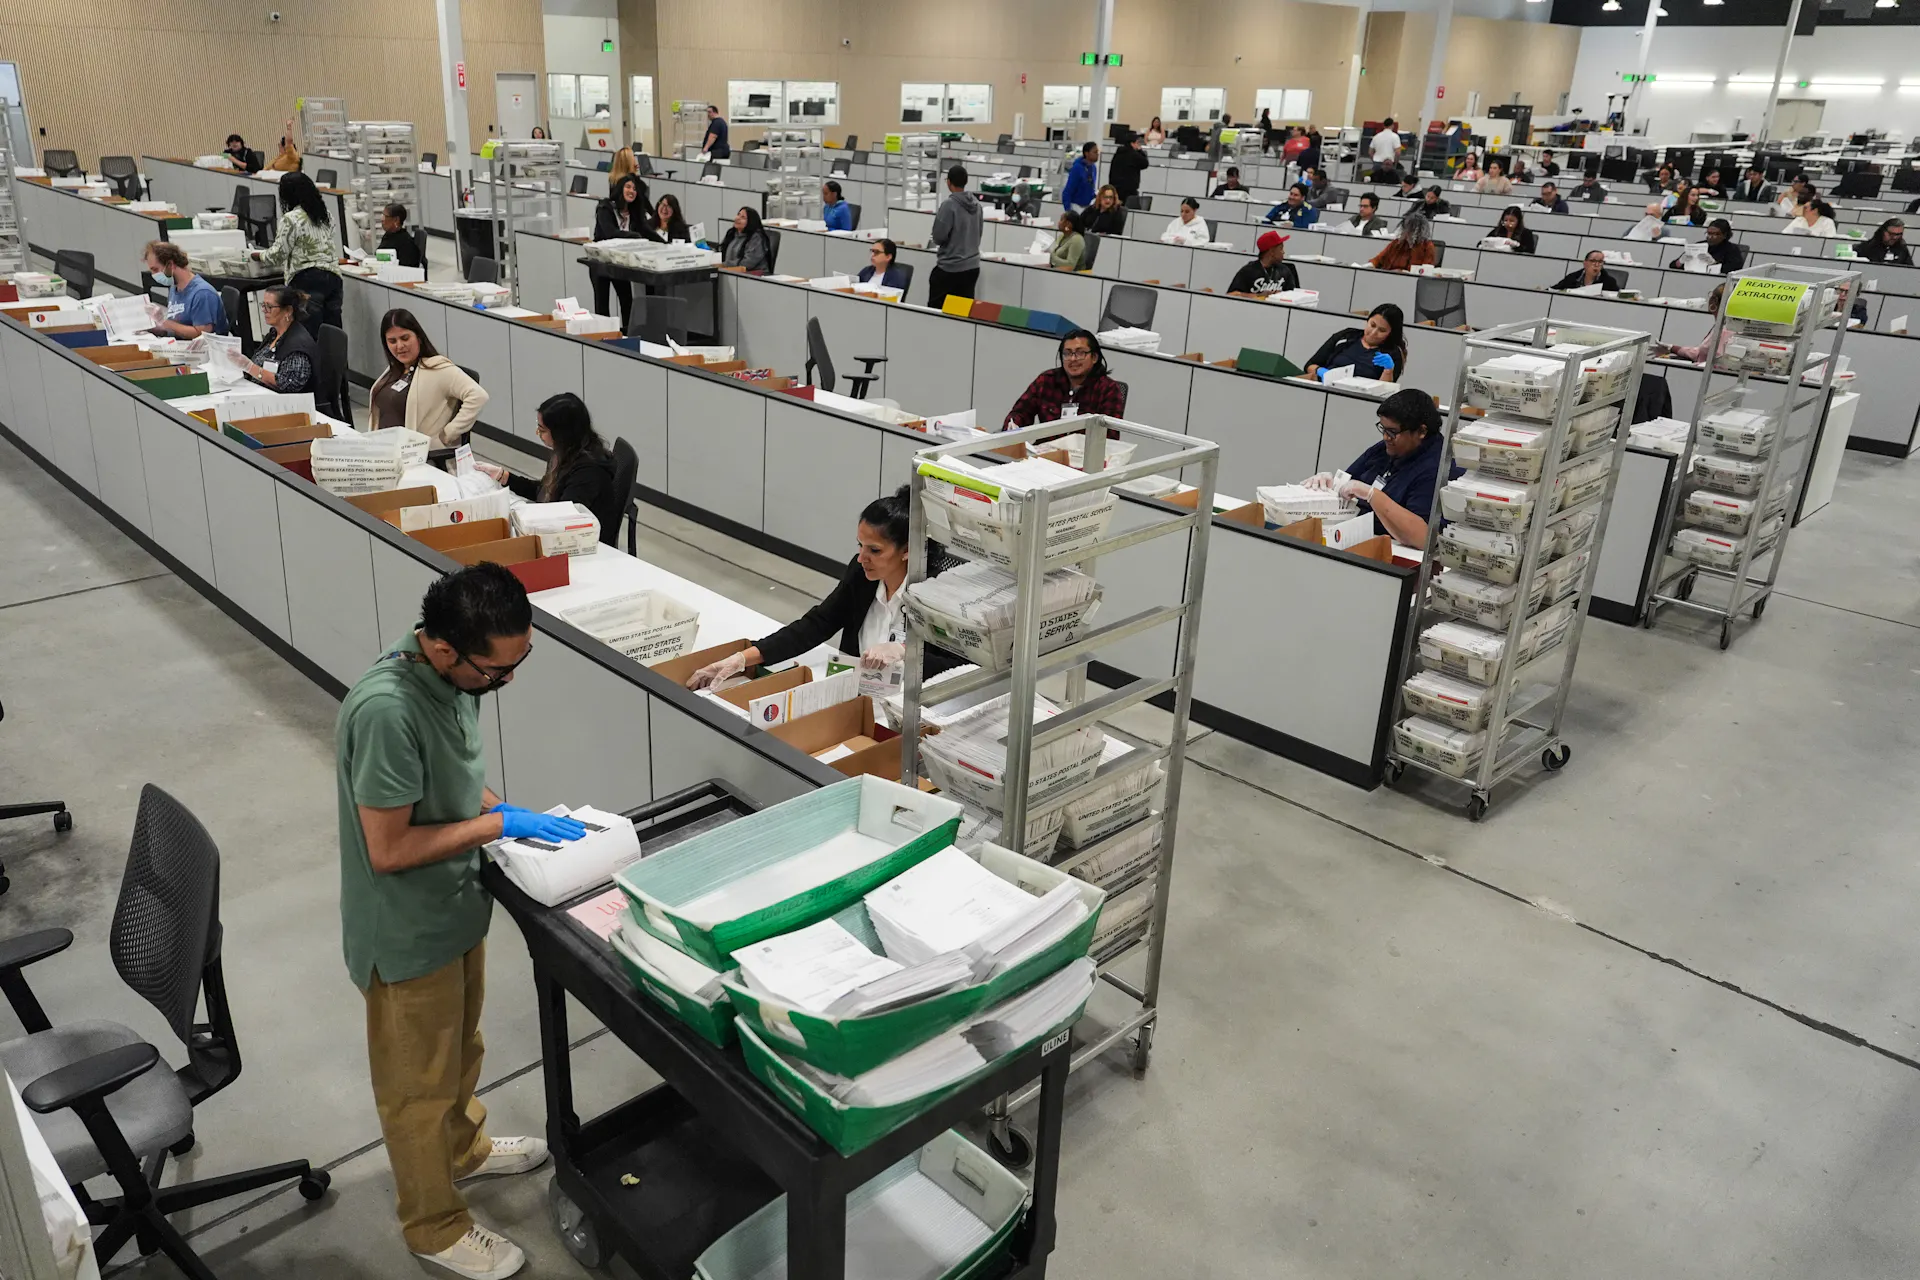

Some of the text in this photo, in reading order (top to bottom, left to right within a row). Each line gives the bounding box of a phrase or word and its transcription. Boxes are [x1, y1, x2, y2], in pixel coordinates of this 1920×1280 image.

[1746, 280, 1776, 288] READY
[1736, 290, 1796, 302] EXTRACTION
[1047, 505, 1113, 529] TATES POSTAL SERVICE
[1048, 610, 1079, 626] STATES
[609, 617, 695, 644] UNITED STATES POSTAL SERVICE
[958, 628, 979, 637] LABEL
[1045, 618, 1080, 638] SERVICE
[626, 636, 682, 655] UNITED STATES
[959, 633, 982, 643] OTHER
[653, 643, 684, 657] SERVICE
[1035, 750, 1102, 785] STATES POSTAL SERVICE
[1078, 810, 1100, 820] UNITED
[1101, 801, 1122, 813] STATES
[1122, 791, 1142, 804] POSTAL
[1094, 871, 1113, 883] UNITED
[1114, 861, 1133, 874] STATES
[1044, 1031, 1067, 1052] ULINE
